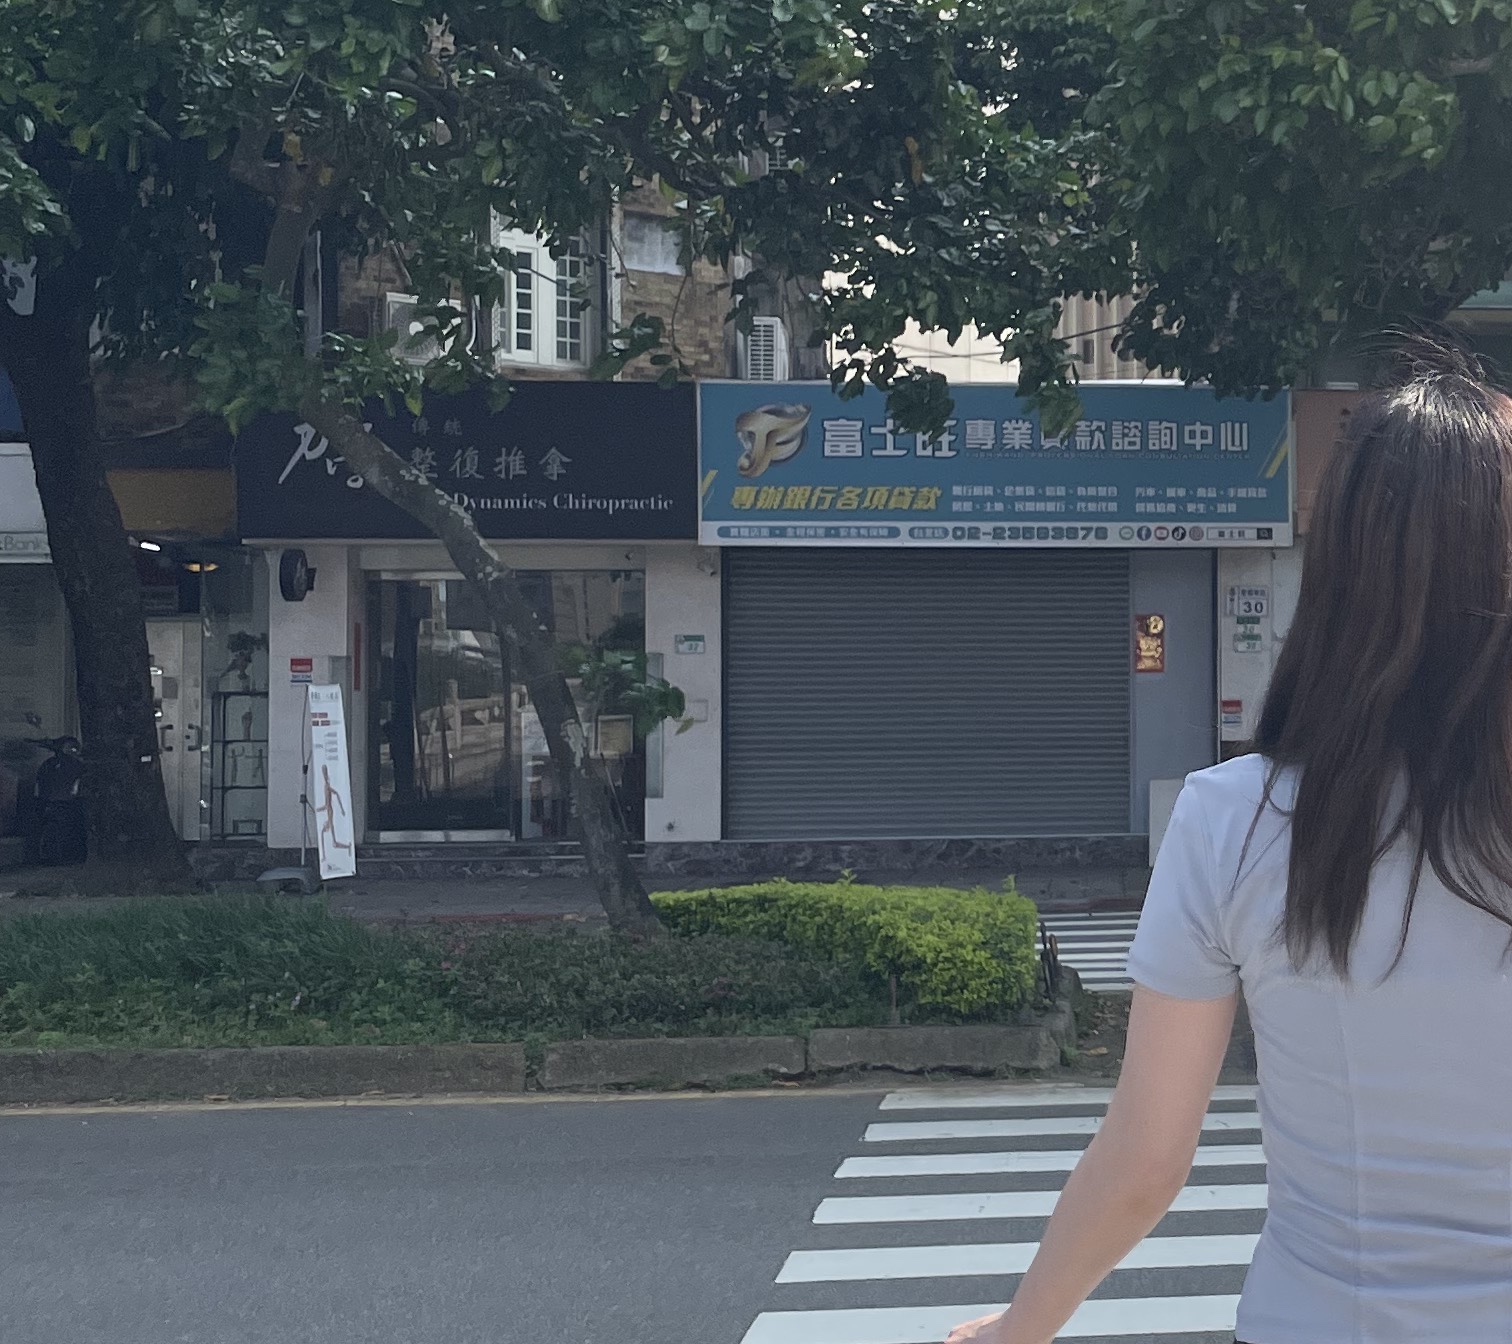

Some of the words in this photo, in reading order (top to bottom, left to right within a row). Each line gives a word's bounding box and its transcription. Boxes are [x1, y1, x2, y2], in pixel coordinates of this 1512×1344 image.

[411, 446, 572, 481] 整復推拿
[453, 493, 547, 515] Dynamics
[553, 493, 673, 515] Chiropractic
[1243, 600, 1264, 614] 30
